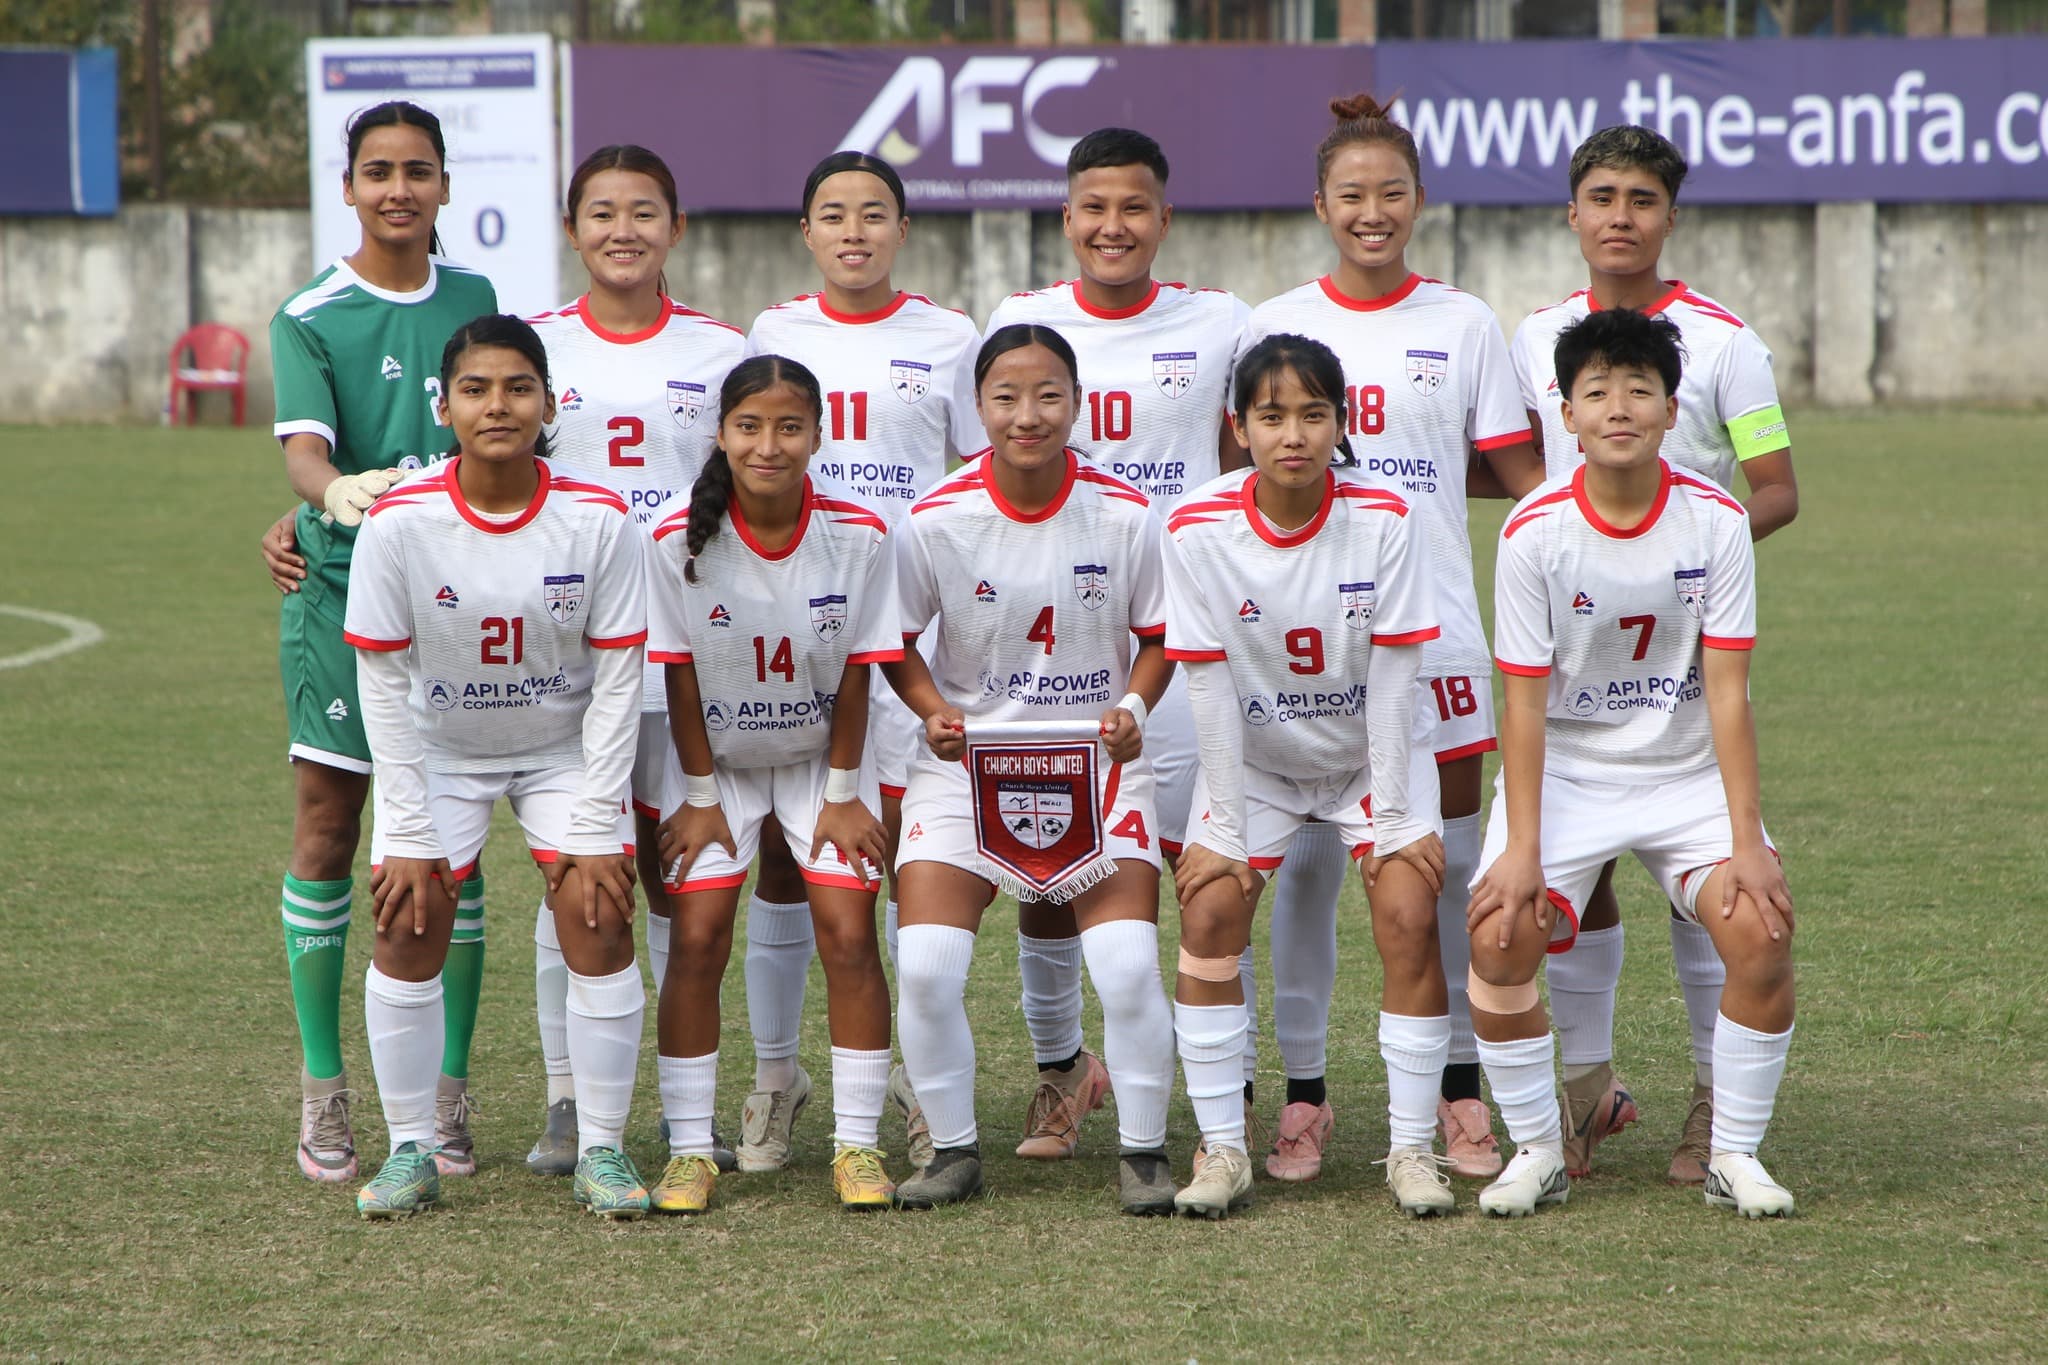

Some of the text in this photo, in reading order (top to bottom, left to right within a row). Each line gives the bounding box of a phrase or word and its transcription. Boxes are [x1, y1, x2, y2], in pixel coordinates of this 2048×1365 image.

[831, 56, 1100, 167] AFC
[826, 391, 868, 441] 11
[1088, 390, 1132, 441] 10
[1346, 384, 1386, 436] 18
[606, 415, 646, 468] 2
[1113, 461, 1186, 482] POWER
[480, 616, 524, 665] 21
[1025, 605, 1056, 656] 4
[1619, 613, 1657, 661] 7
[752, 635, 796, 683] 14
[1284, 626, 1326, 676] 9
[462, 682, 499, 699] API
[1007, 671, 1035, 691] API
[1038, 669, 1111, 692] POWER
[1607, 680, 1642, 697] API
[462, 698, 533, 710] COMPANY
[1065, 689, 1111, 705] LIMITED
[1276, 684, 1368, 708] API POWE
[1430, 676, 1479, 722] 18
[1606, 698, 1669, 712] COMPANY
[737, 701, 773, 718] API
[1278, 707, 1341, 723] COMPANY
[737, 718, 807, 731] COMPANY
[983, 754, 1084, 776] CHURCH BOYS UNITED
[1000, 782, 1024, 790] Church
[1044, 783, 1071, 791] United
[1108, 809, 1151, 851] 4
[295, 933, 343, 953] sports
